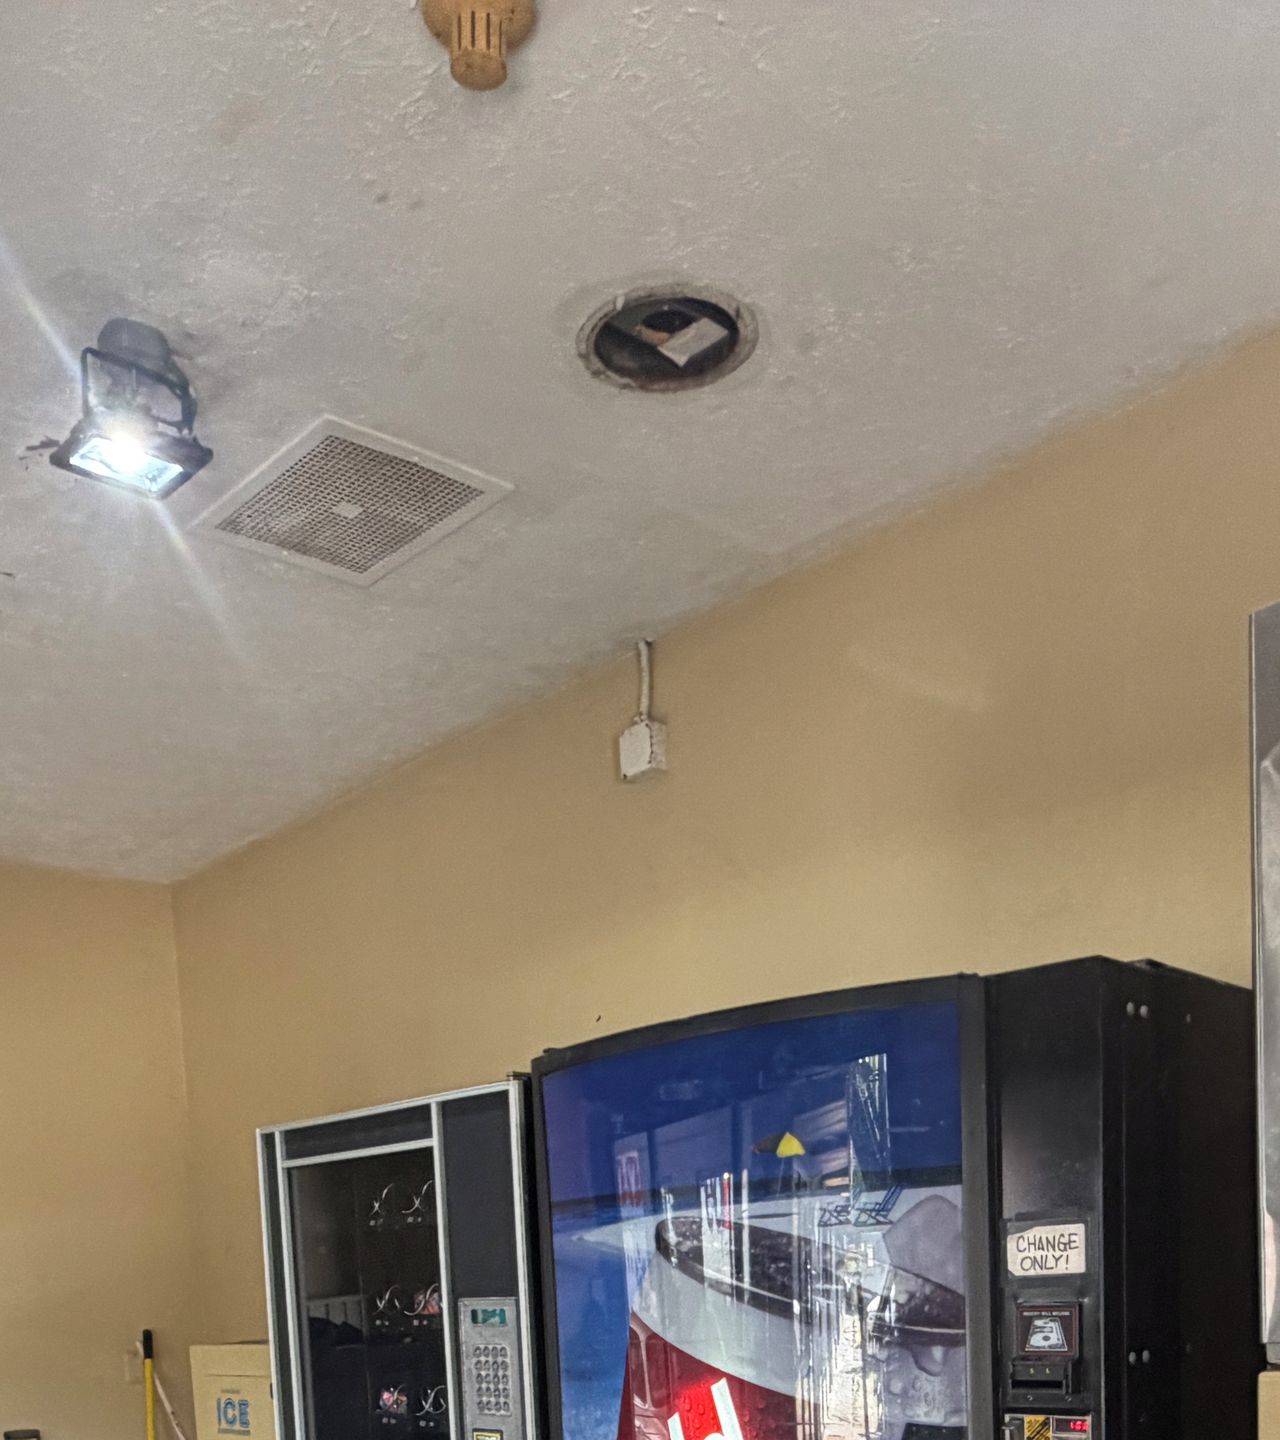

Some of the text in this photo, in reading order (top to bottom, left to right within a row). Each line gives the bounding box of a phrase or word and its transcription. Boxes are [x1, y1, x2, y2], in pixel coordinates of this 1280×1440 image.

[1016, 1232, 1079, 1253] CHANGE
[1020, 1254, 1069, 1272] ONLY!
[216, 1397, 250, 1429] ICE
